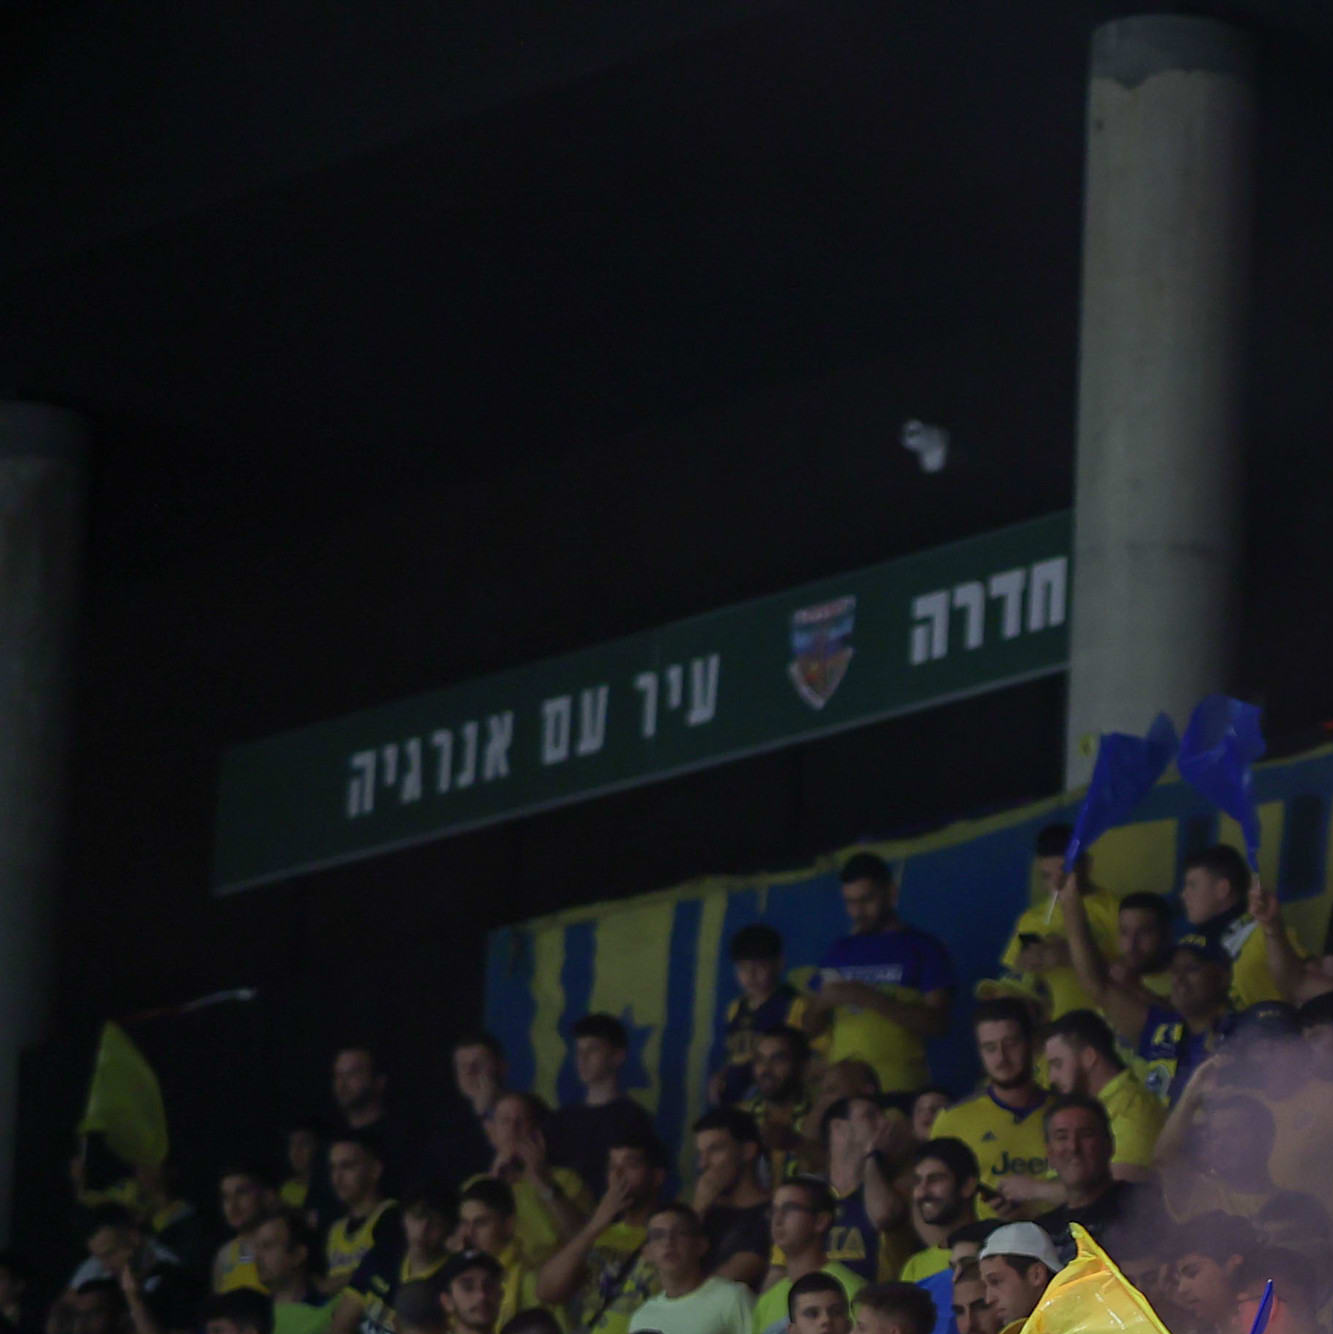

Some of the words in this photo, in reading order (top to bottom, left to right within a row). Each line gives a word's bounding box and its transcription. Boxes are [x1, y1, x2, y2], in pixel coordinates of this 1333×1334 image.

[909, 555, 1068, 667] חדרה
[540, 684, 608, 765] עם
[632, 653, 721, 738] עיר
[345, 711, 514, 819] אנרגיה
[992, 1151, 1048, 1176] Jee
